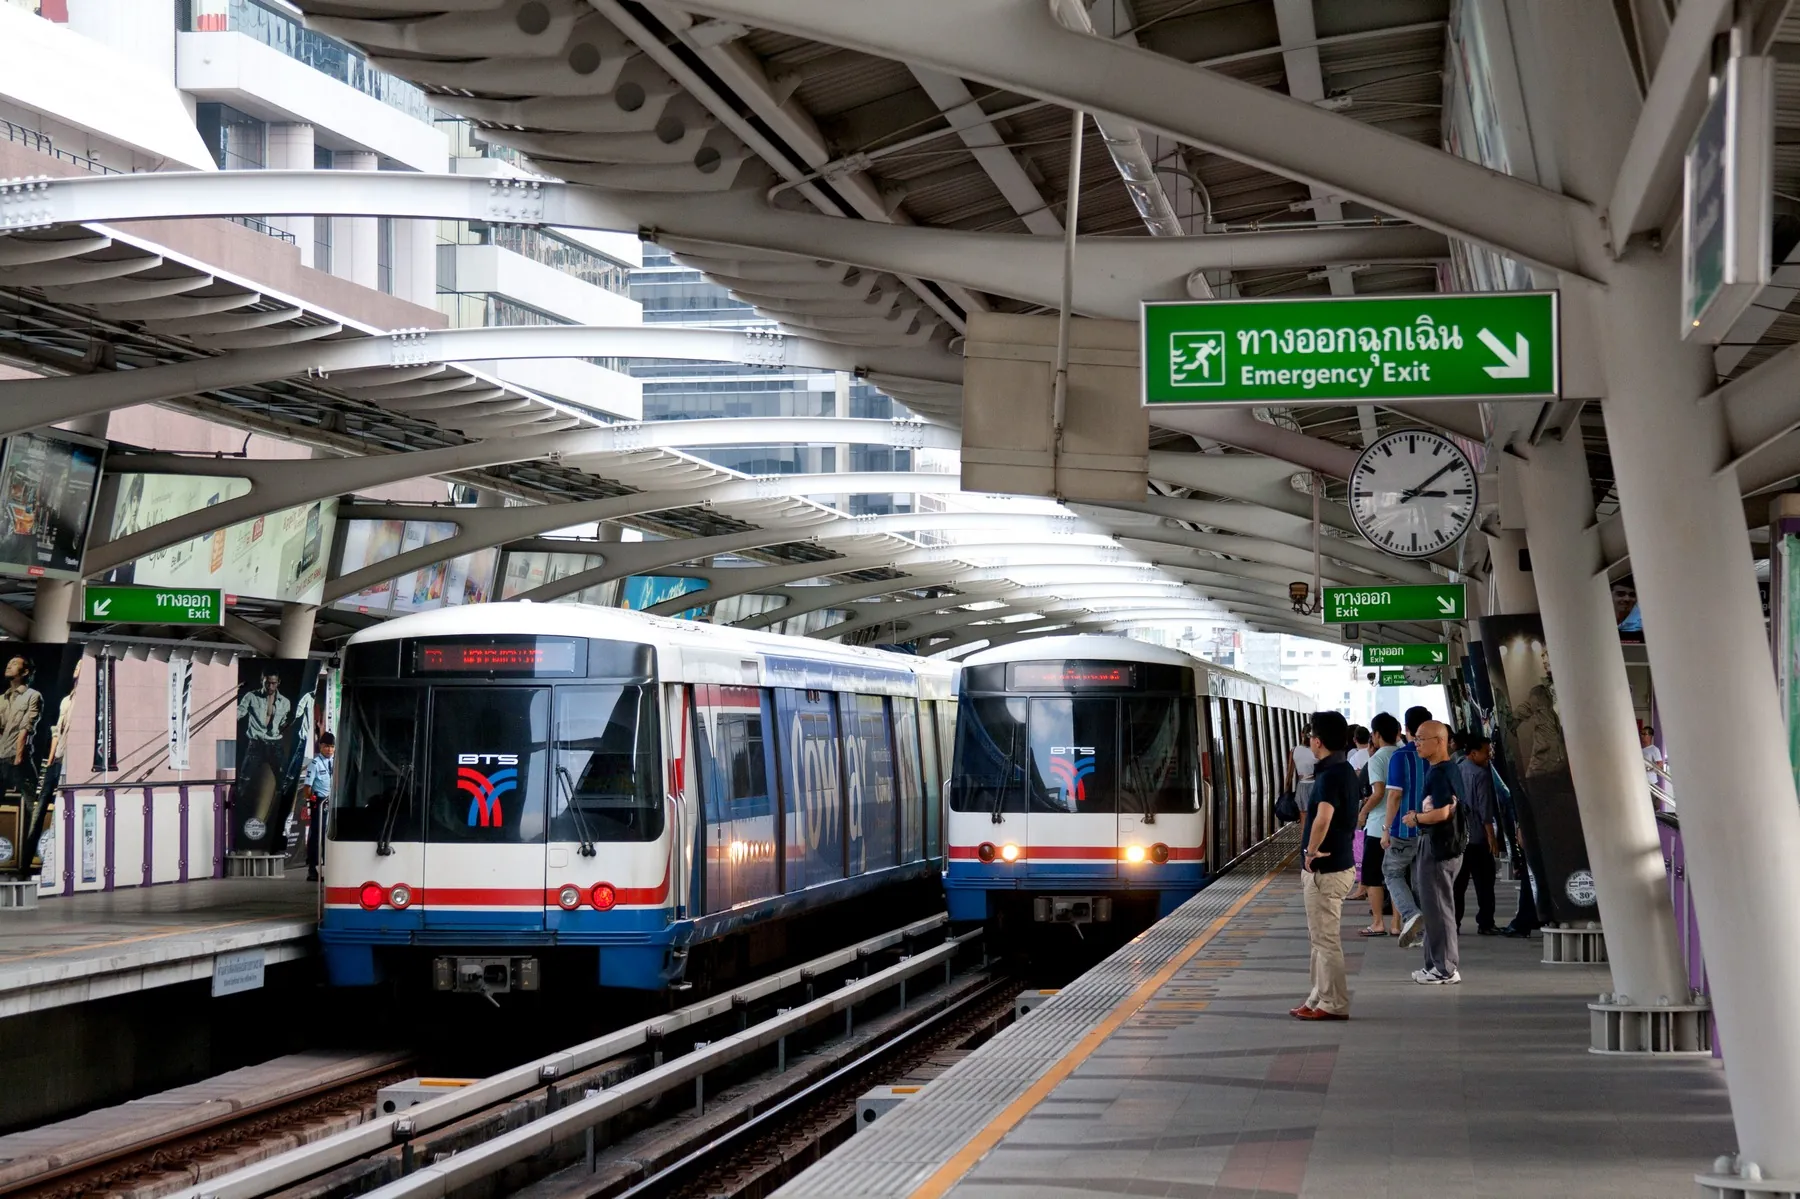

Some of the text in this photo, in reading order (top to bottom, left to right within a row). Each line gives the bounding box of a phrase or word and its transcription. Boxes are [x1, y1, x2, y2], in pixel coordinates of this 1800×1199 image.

[1237, 314, 1464, 367] ทางออกฉุกเฉิน
[1241, 361, 1431, 390] Emergency Exit
[156, 593, 211, 609] ทางออก
[1334, 591, 1391, 606] ทางออก
[188, 608, 211, 619] Exit
[1335, 606, 1359, 617] Exit
[1368, 647, 1404, 656] ทางออก
[1050, 746, 1096, 755] BTS
[458, 753, 519, 766] BTS
